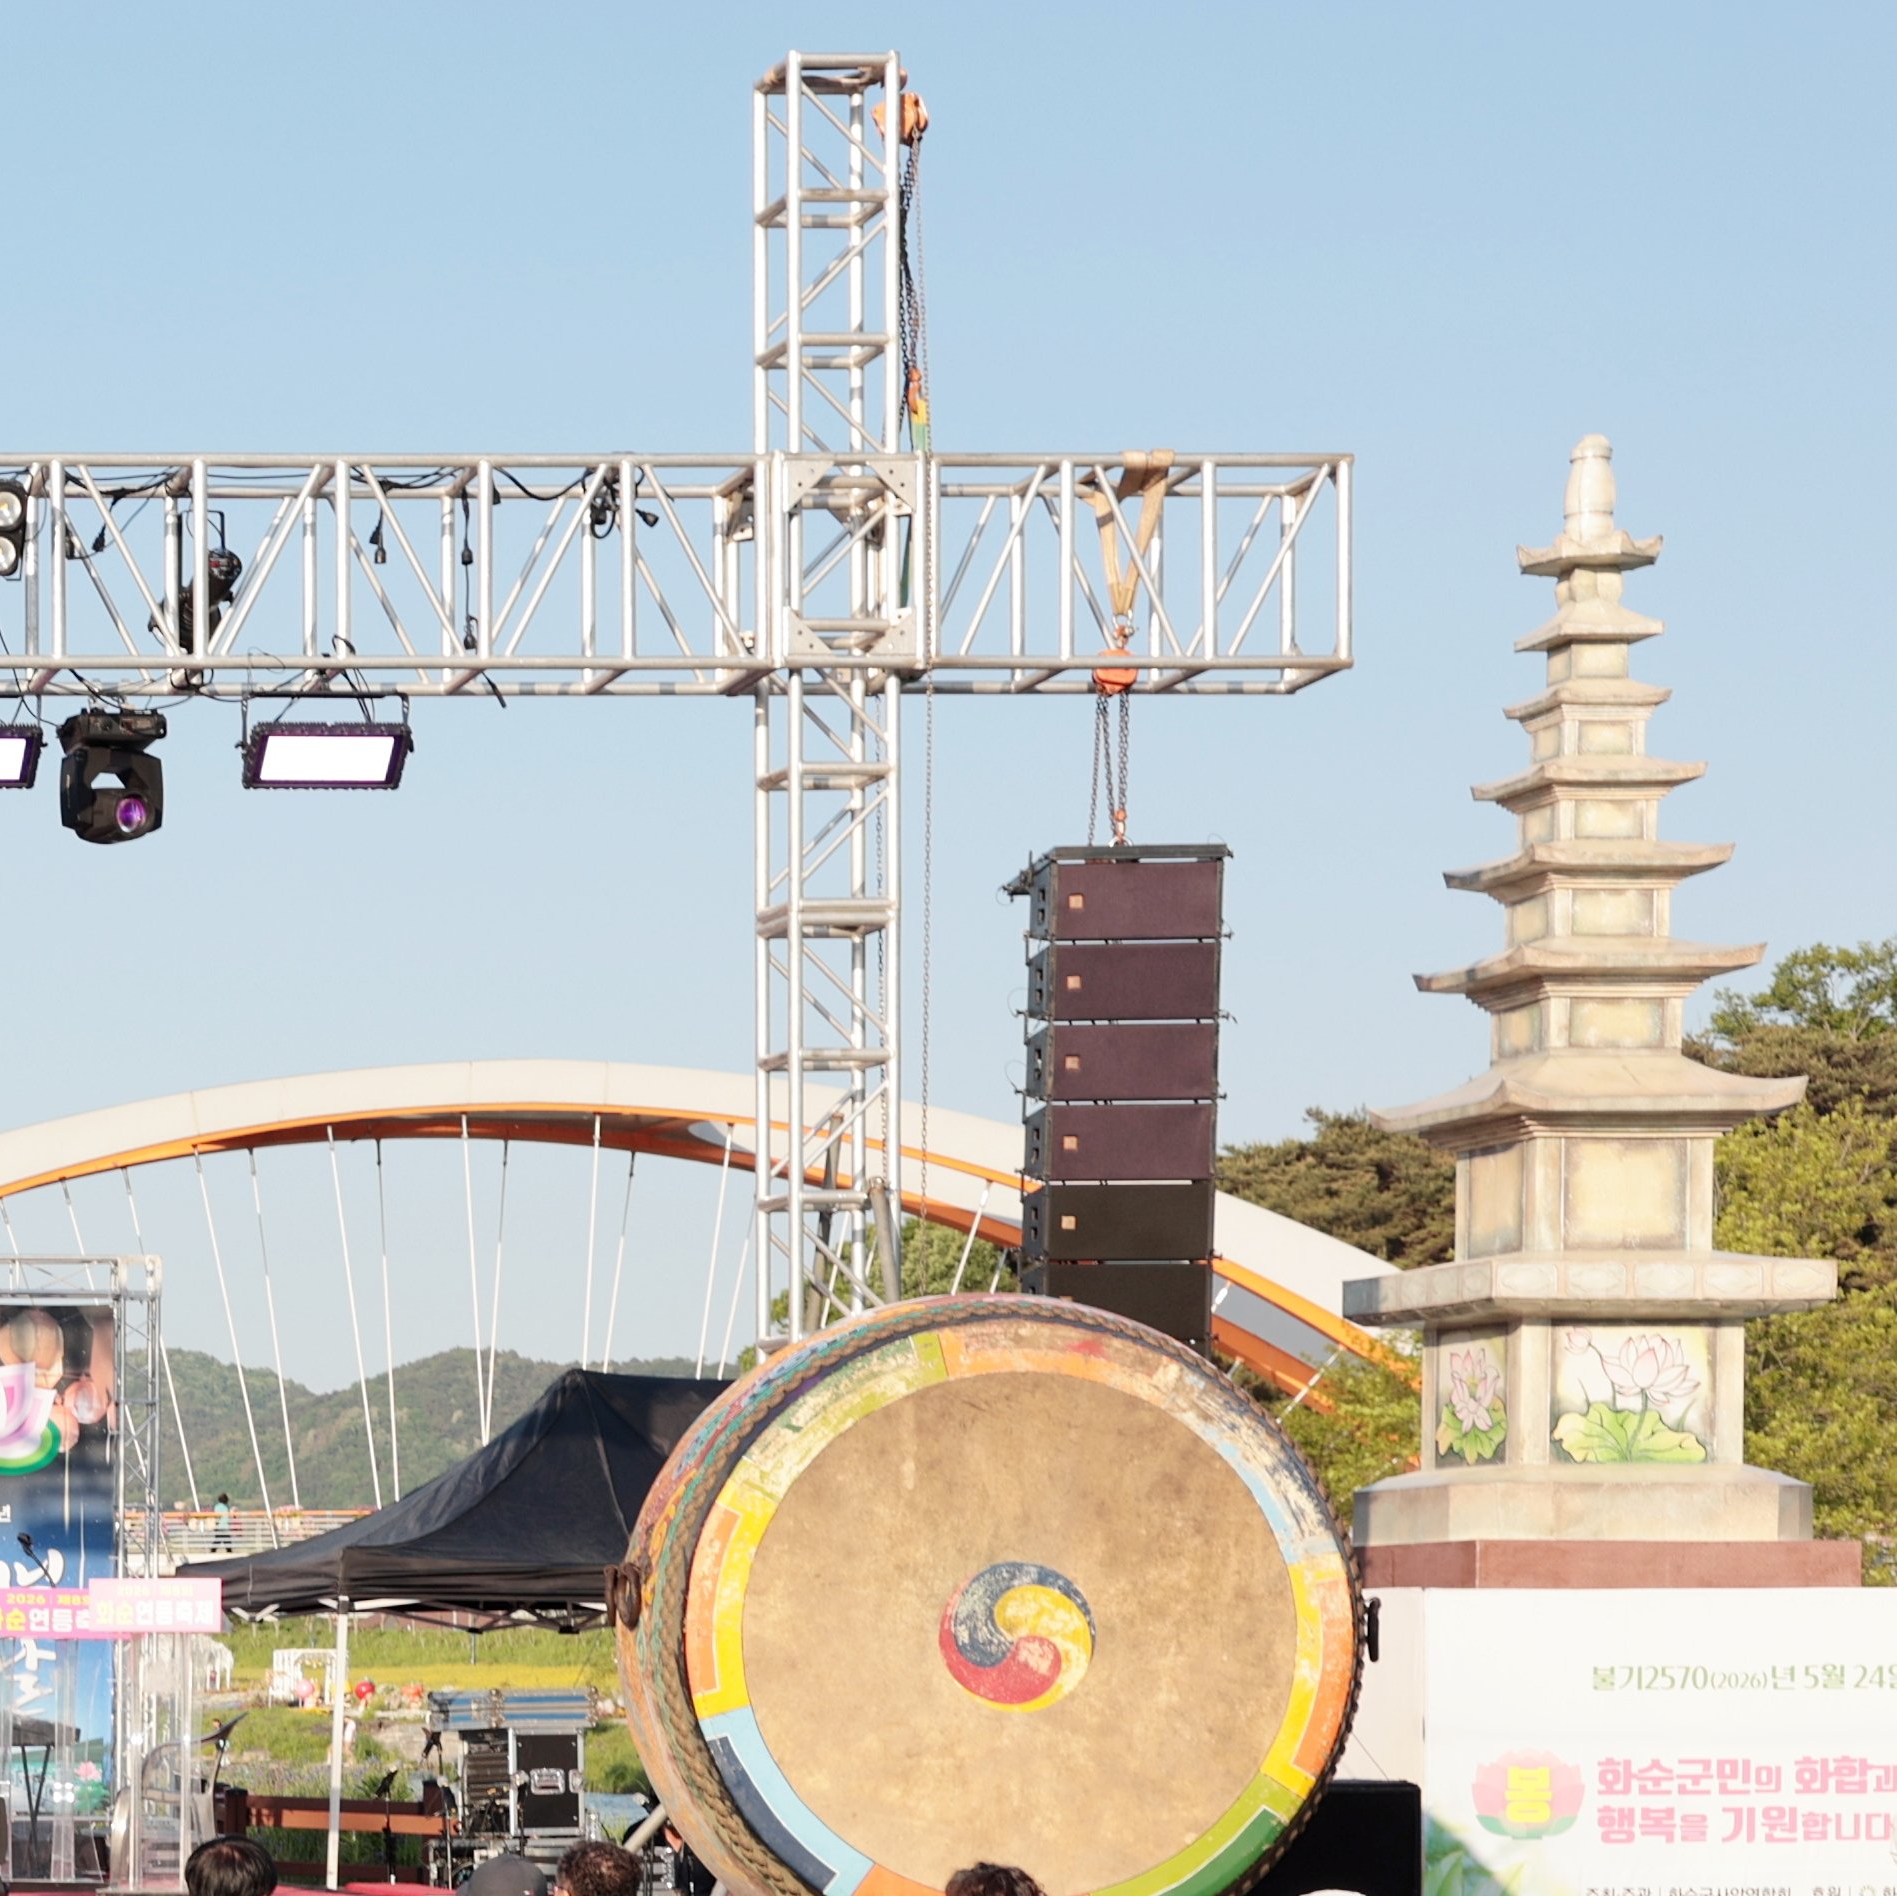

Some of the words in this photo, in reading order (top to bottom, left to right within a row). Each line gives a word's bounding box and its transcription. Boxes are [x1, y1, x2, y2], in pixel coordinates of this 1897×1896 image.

[6, 1593, 47, 1605] 2026
[1803, 1663, 1846, 1691] 5월
[1505, 1766, 1553, 1824] 봉
[1596, 1756, 1783, 1796] 화순군민의
[1596, 1805, 1709, 1845] 행복을
